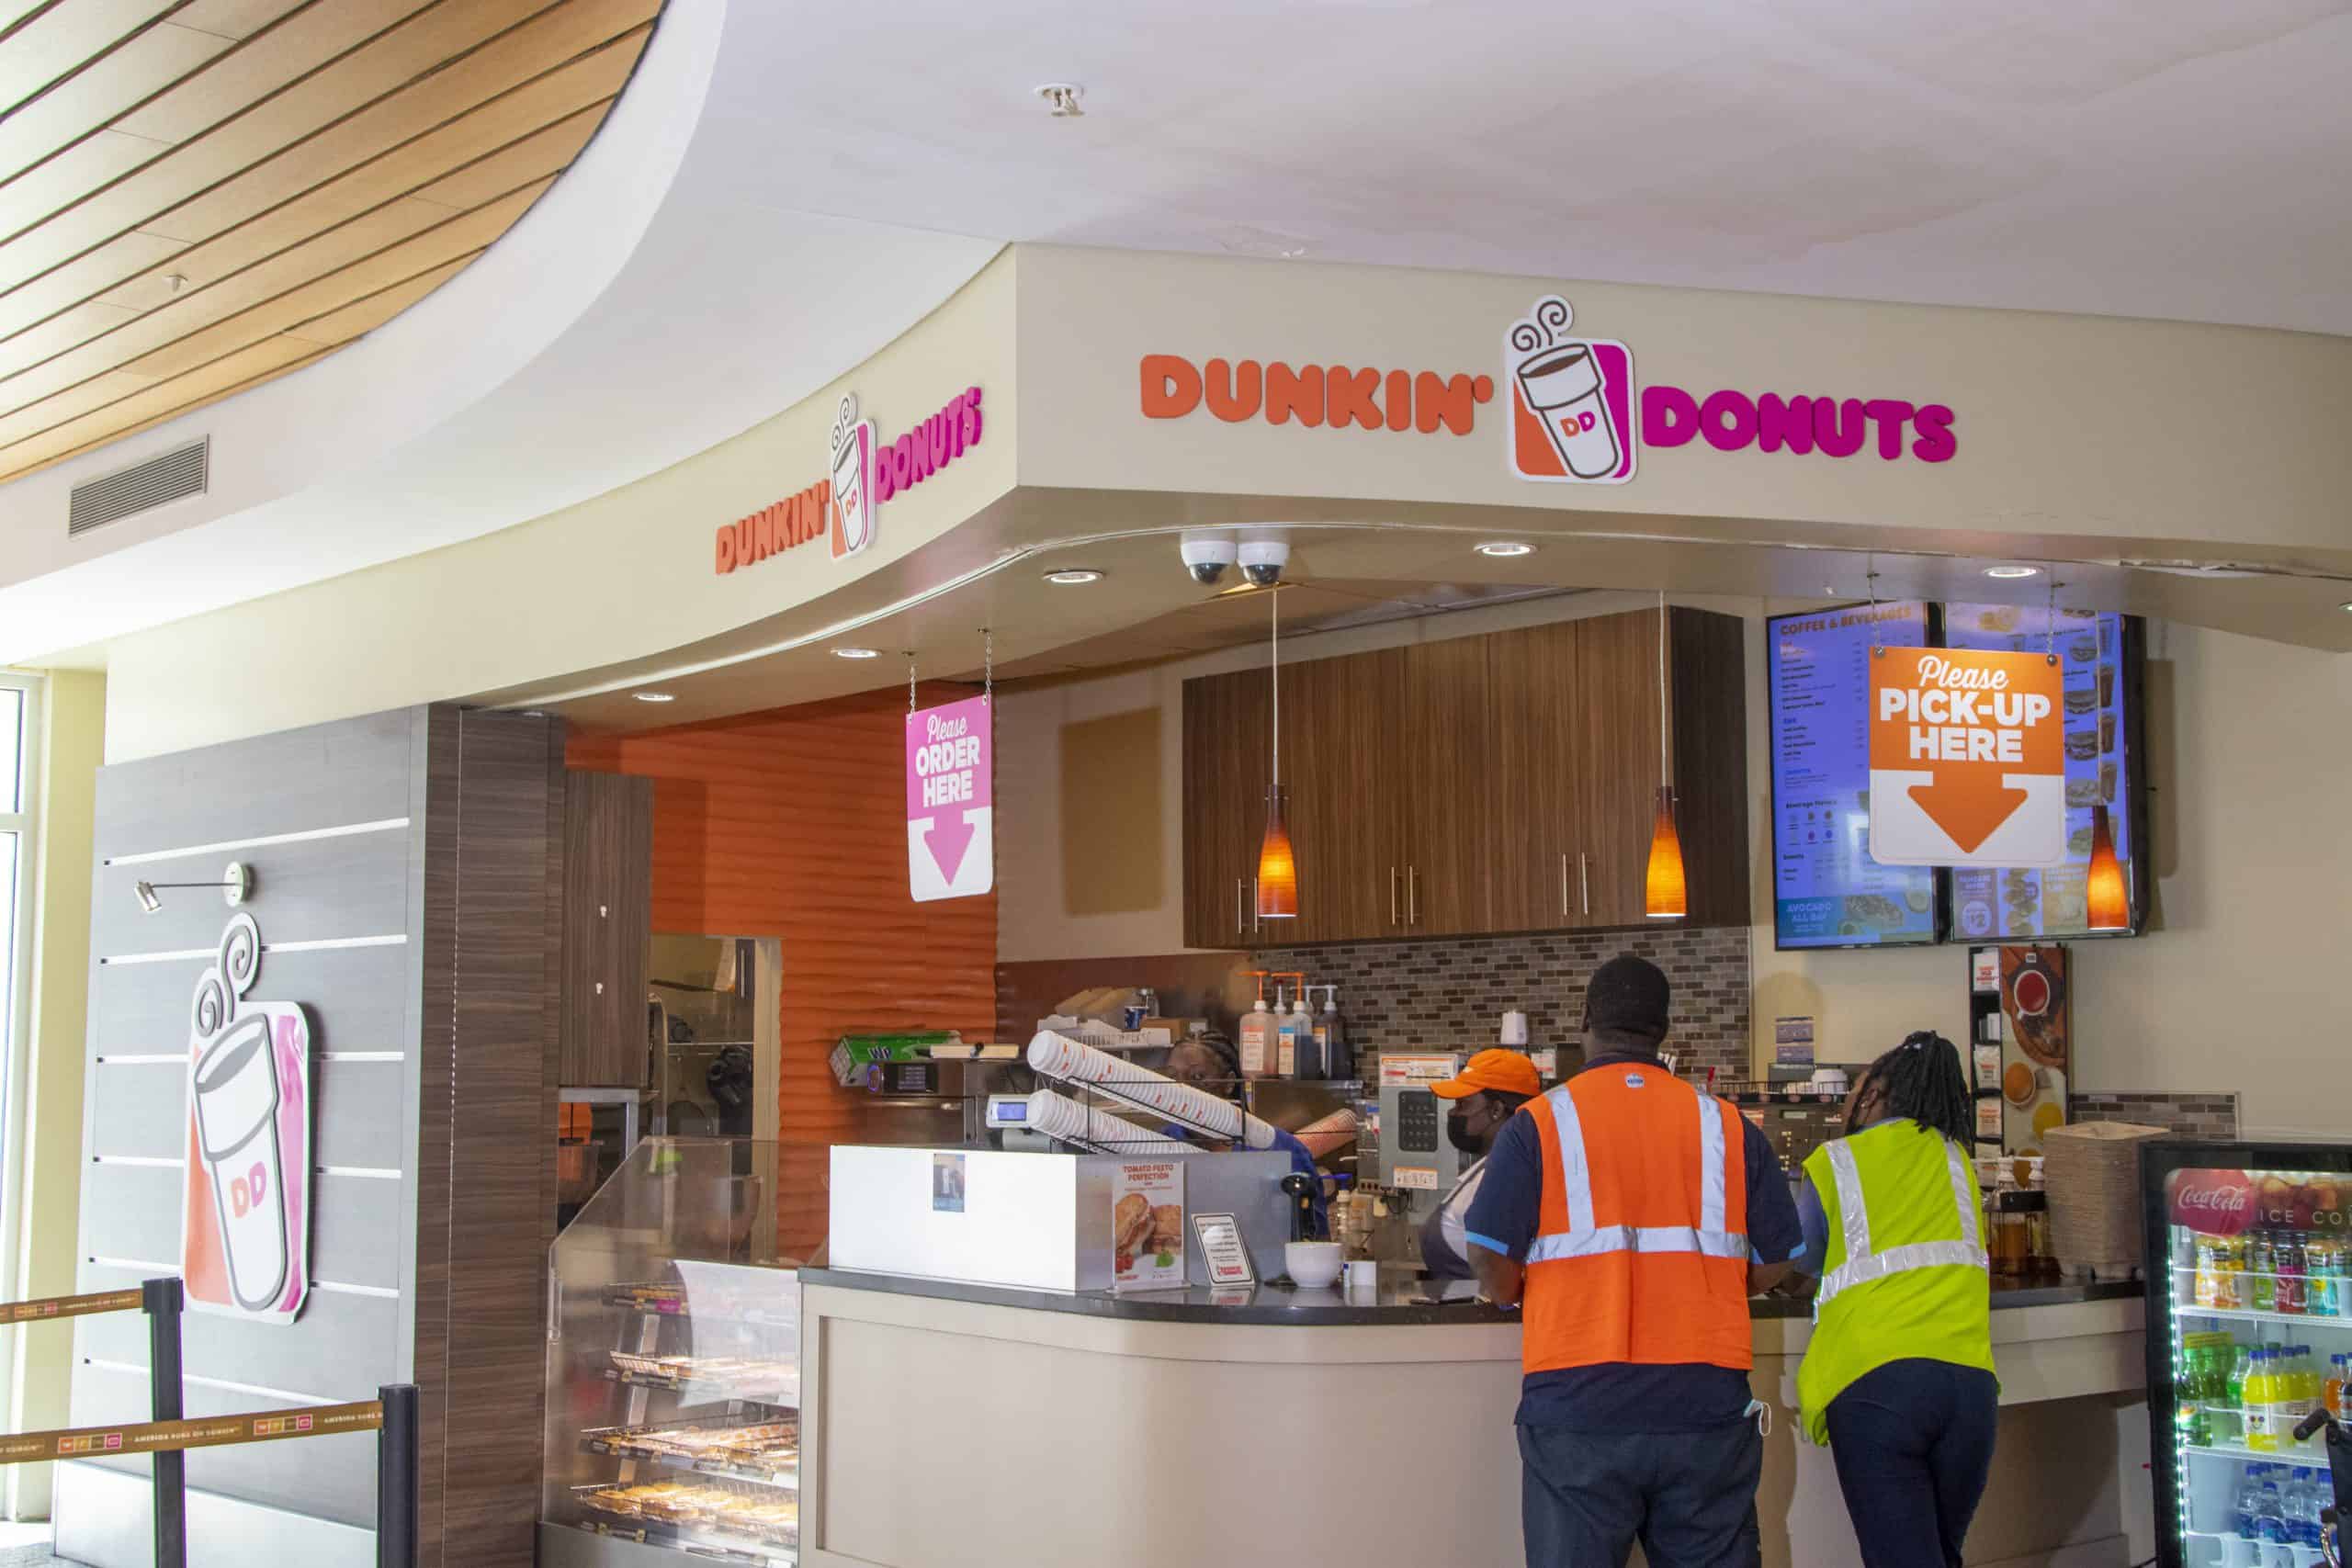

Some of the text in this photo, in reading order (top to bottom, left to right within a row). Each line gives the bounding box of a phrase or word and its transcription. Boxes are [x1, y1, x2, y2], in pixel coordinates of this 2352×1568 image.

[1140, 354, 1957, 464] DUNKIN' DONUTS
[1559, 411, 1596, 438] DD
[716, 386, 983, 575] DUNKIN' DONUTS
[1781, 606, 1912, 636] COFFEE & BEVERAGES
[1917, 655, 2009, 690] Please
[1880, 688, 2052, 727] PICK-UP
[927, 714, 967, 743] Please
[1909, 726, 2023, 763] HERE
[915, 735, 980, 777] ORDER
[922, 769, 974, 809] HERE
[1123, 1165, 1150, 1174] TOMATO
[1127, 1172, 1170, 1182] PERFECTION
[230, 1160, 267, 1219] DD
[2259, 1208, 2294, 1224] ICE
